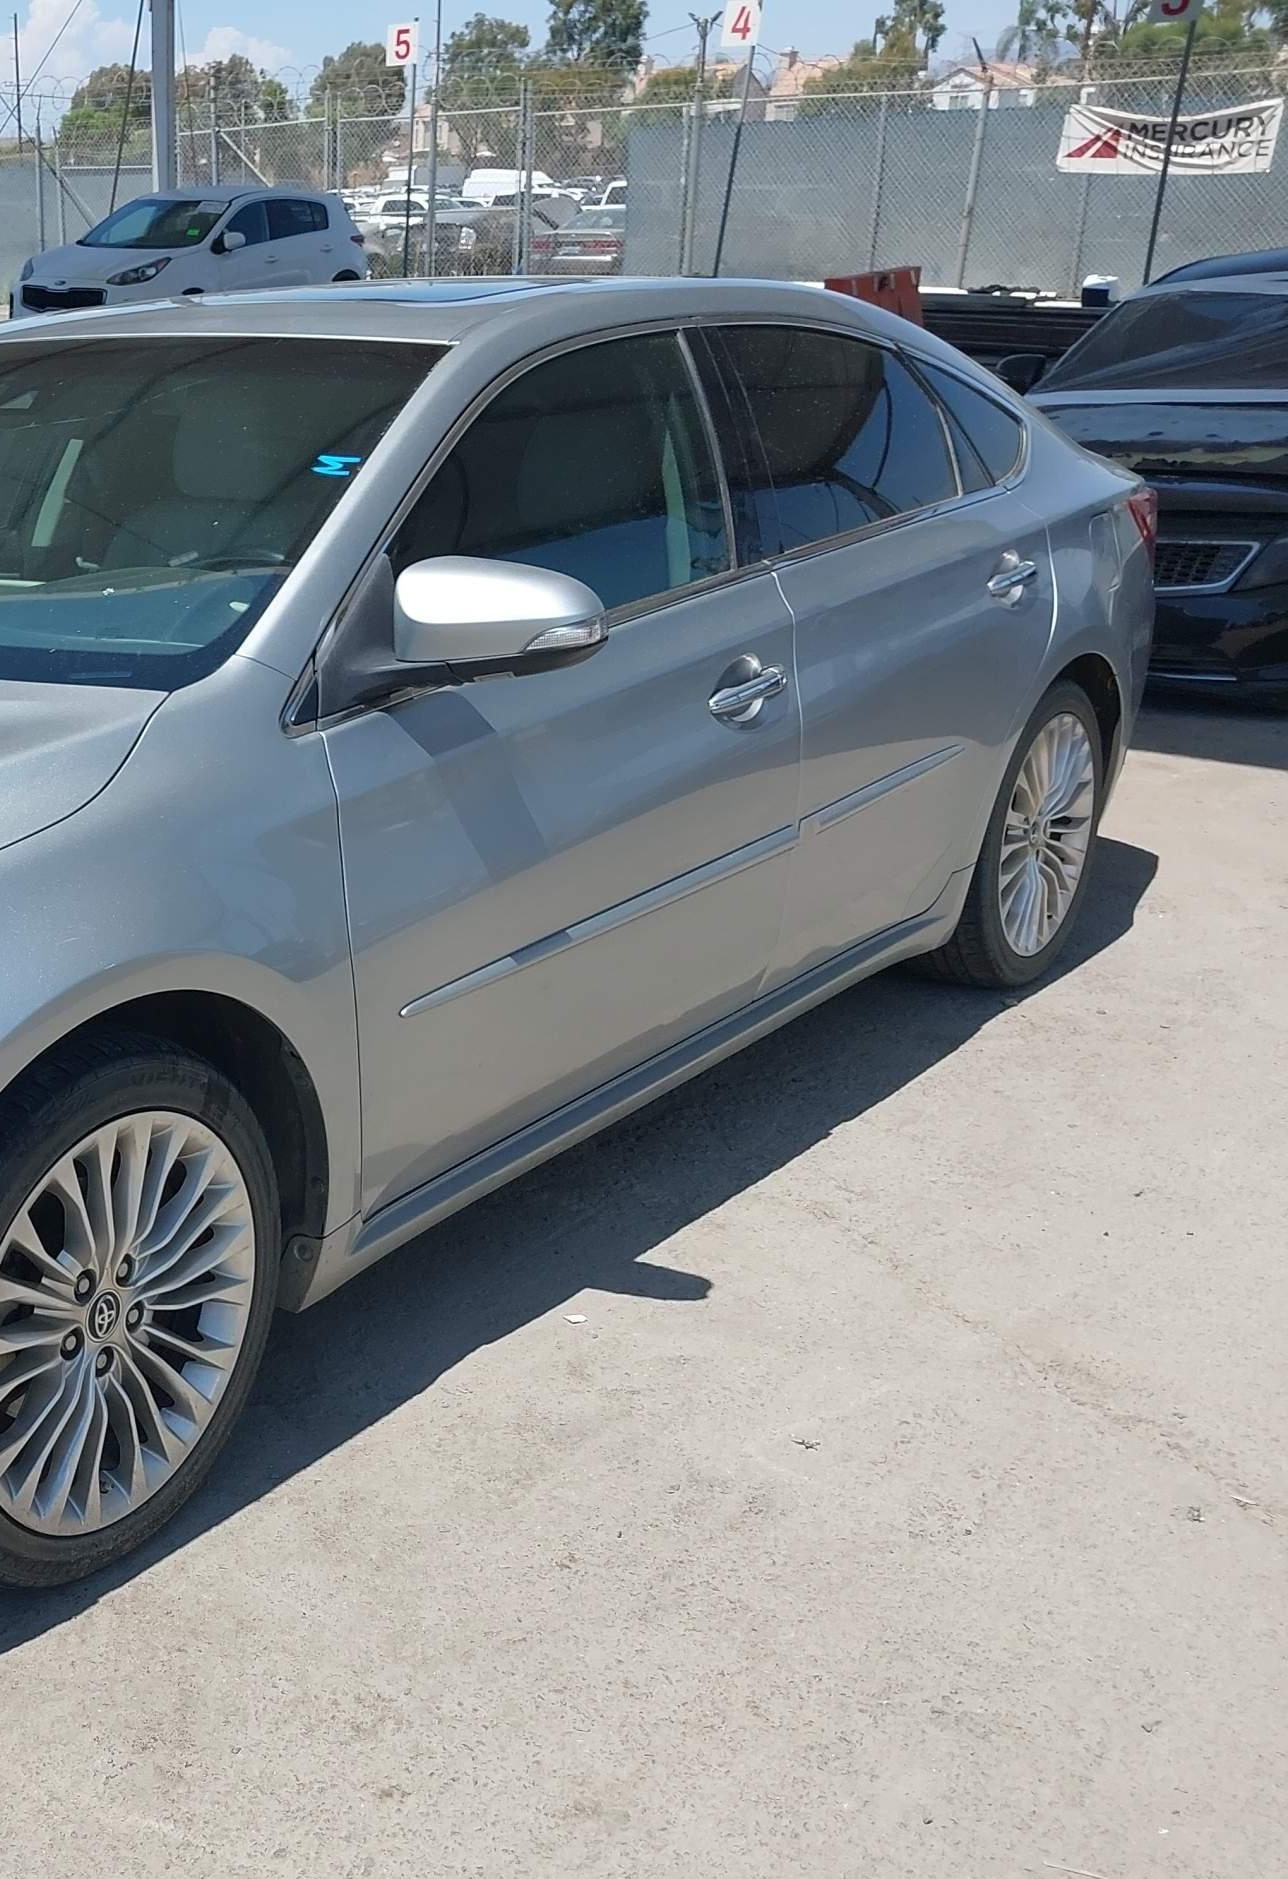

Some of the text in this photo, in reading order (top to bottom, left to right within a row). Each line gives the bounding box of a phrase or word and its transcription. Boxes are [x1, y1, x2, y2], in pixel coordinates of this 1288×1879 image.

[730, 6, 751, 40] 4
[395, 28, 410, 60] 5
[1127, 114, 1276, 142] MERCURY
